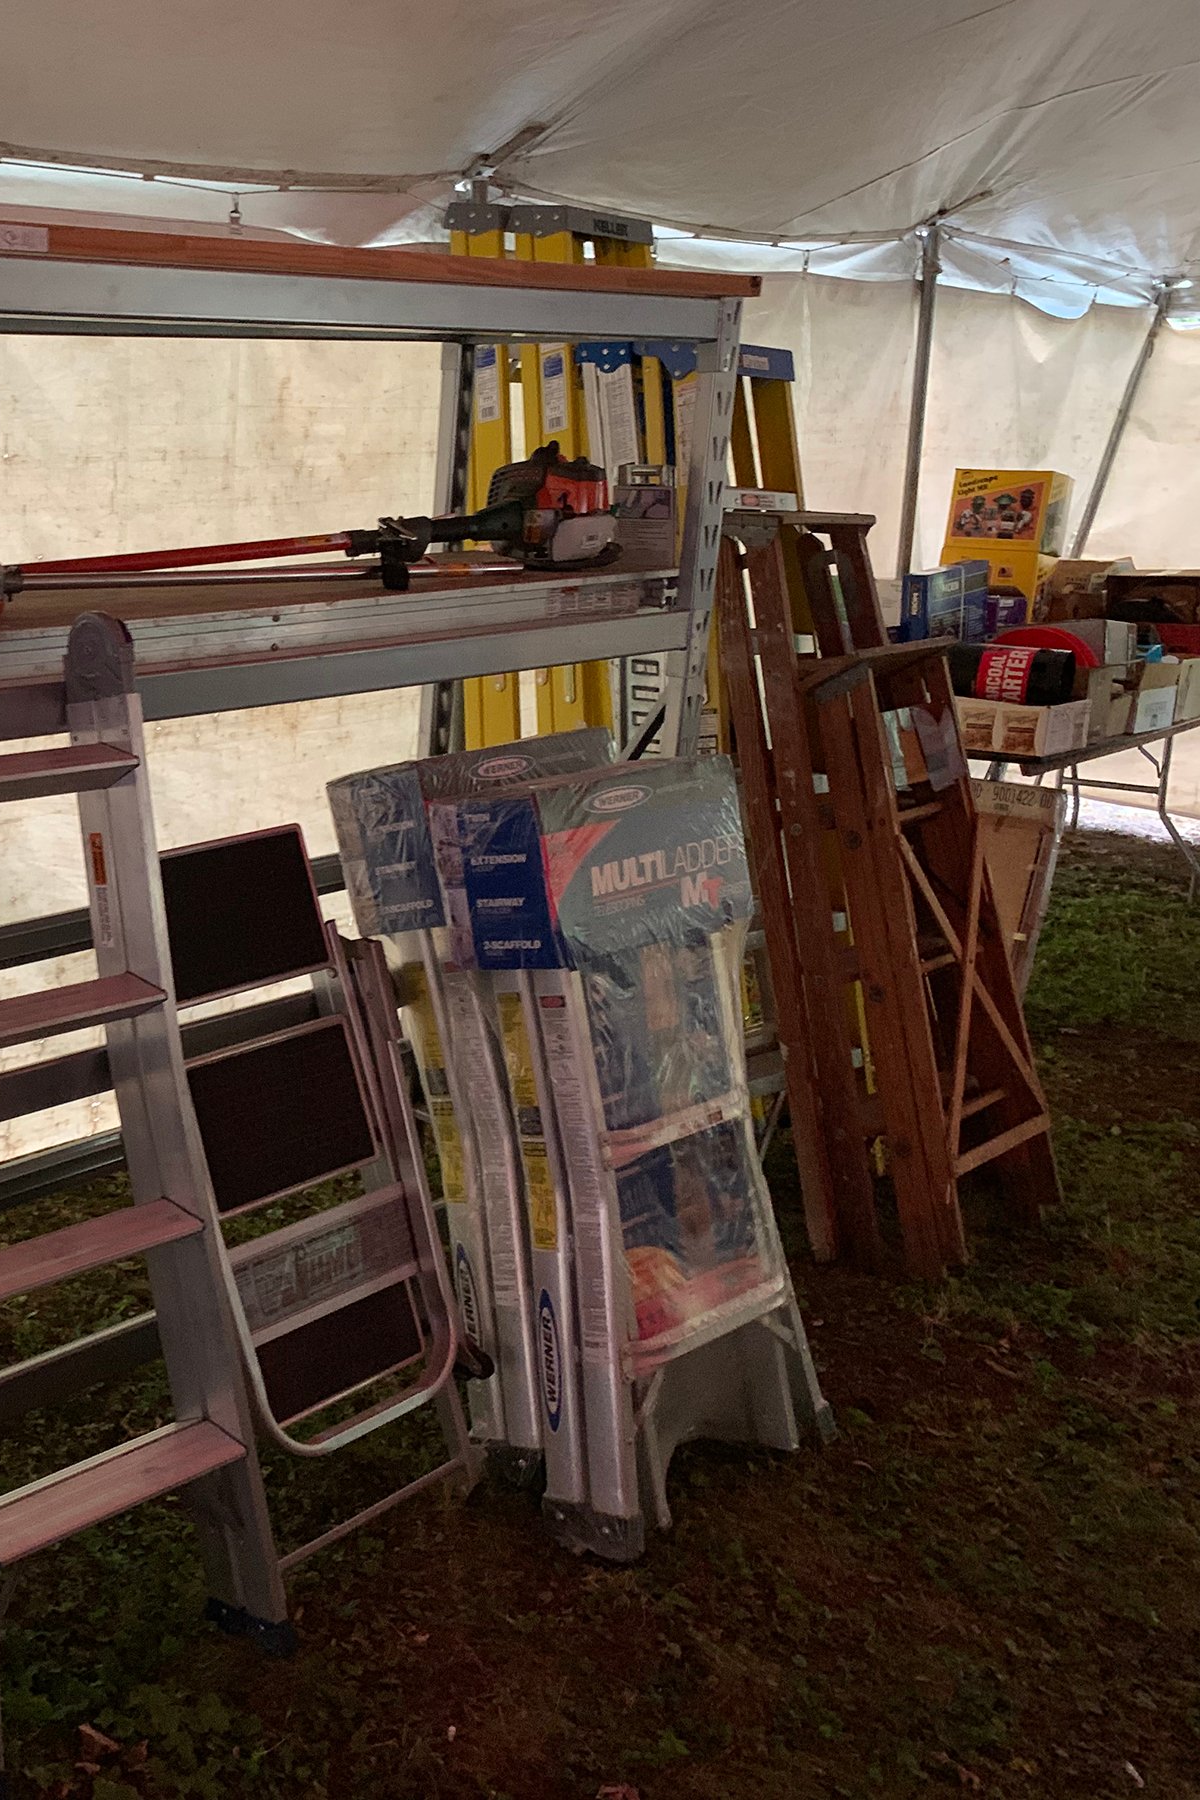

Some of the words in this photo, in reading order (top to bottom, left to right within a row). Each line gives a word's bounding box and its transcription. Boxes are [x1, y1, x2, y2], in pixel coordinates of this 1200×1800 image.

[599, 789, 641, 807] WERNER
[470, 854, 528, 867] EXTENSION
[541, 1315, 558, 1402] WERNER
